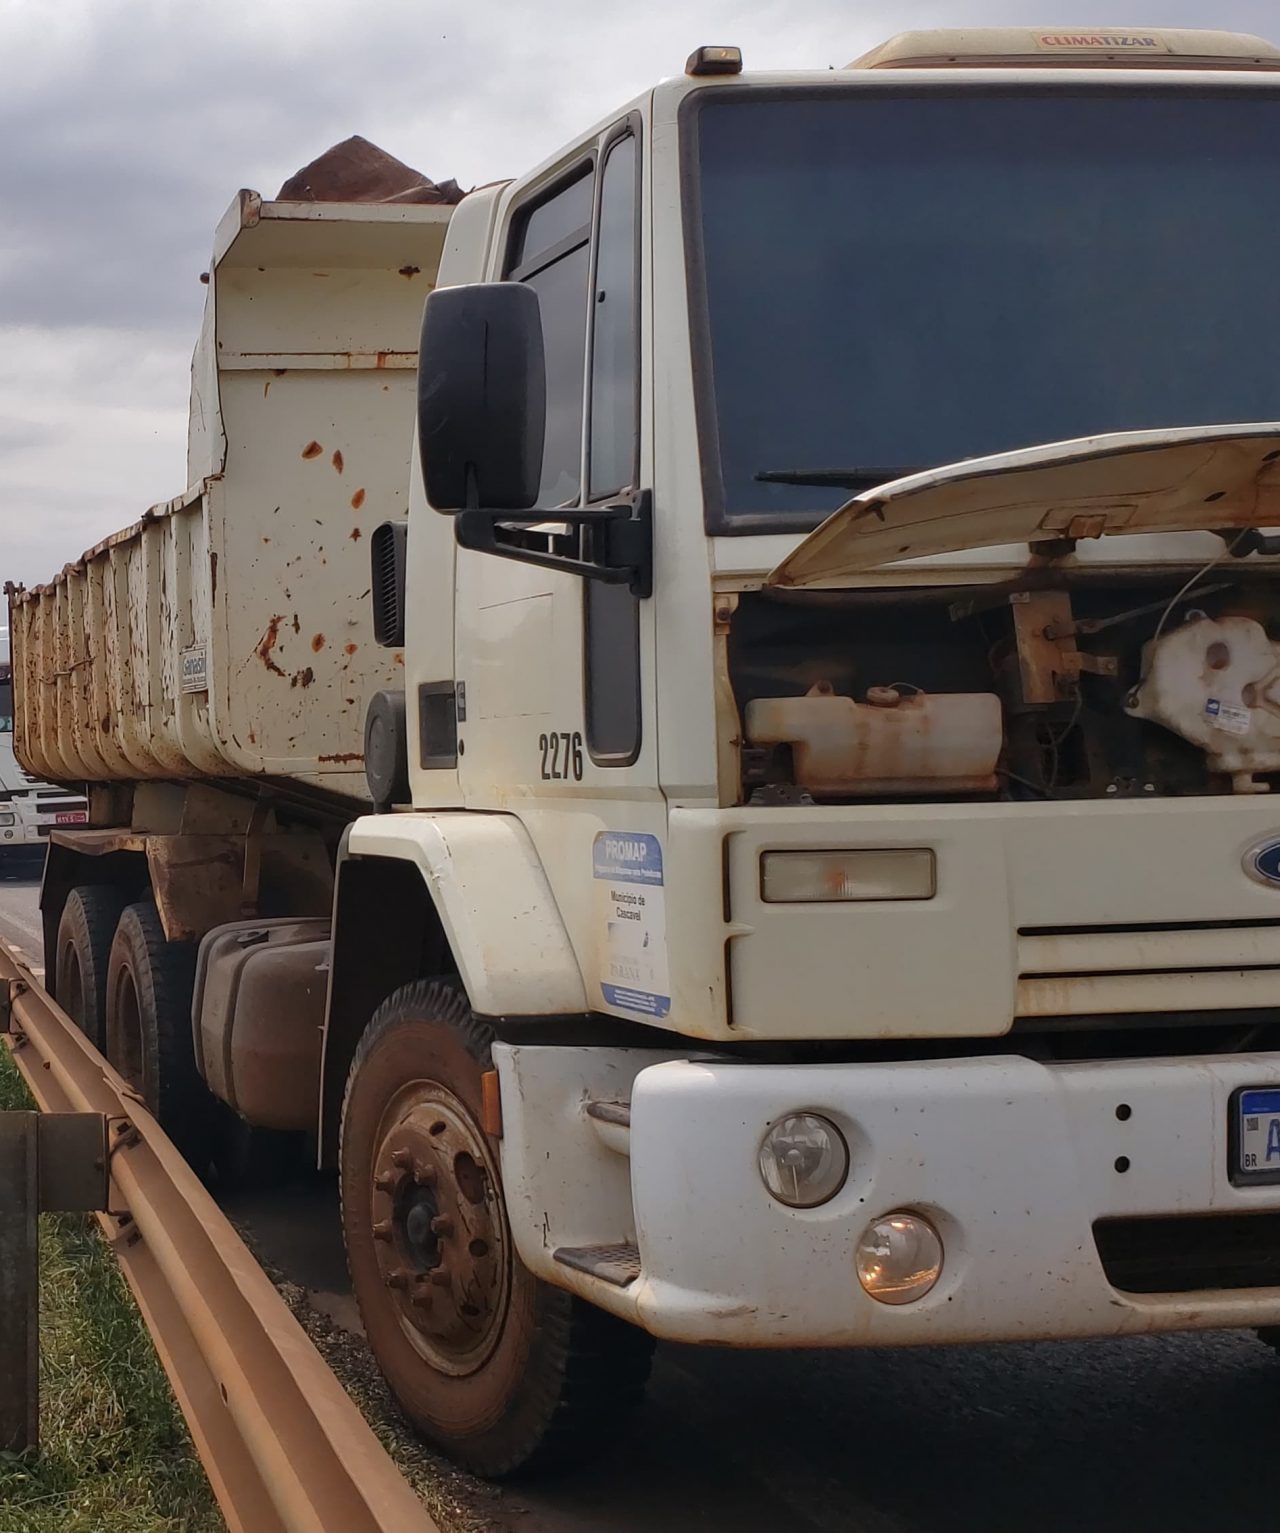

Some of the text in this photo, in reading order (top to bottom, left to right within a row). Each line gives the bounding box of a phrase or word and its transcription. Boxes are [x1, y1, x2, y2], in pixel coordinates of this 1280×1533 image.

[1041, 36, 1158, 47] CLIMATIZAR
[539, 731, 583, 781] 2276
[605, 840, 647, 862] PROMAP
[1245, 1153, 1257, 1167] BR
